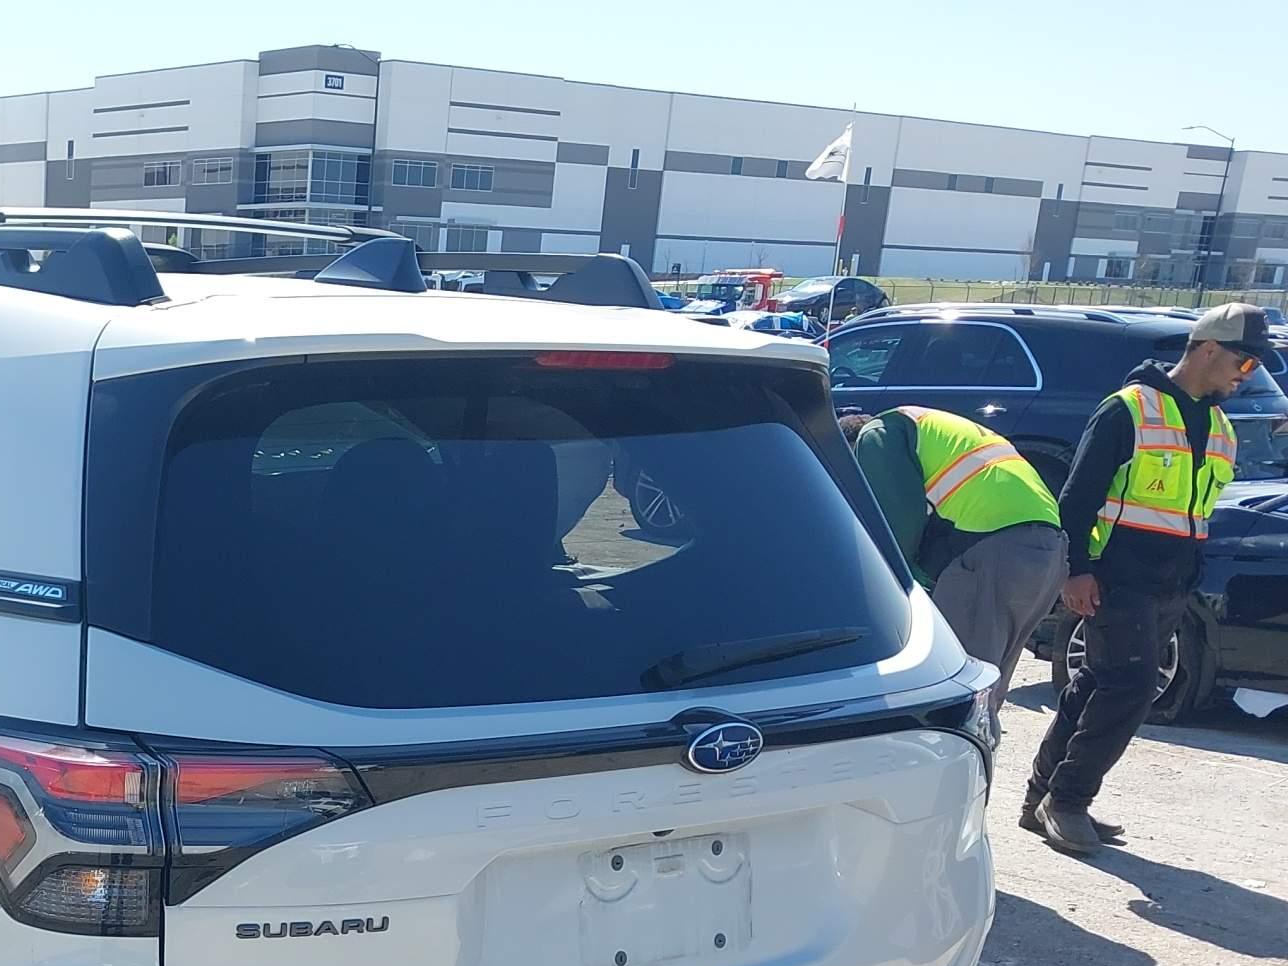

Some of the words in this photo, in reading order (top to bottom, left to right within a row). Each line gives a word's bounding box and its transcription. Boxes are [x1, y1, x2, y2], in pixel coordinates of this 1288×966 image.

[327, 76, 342, 88] 3701
[14, 583, 63, 598] AWD
[476, 753, 900, 829] FORESTER
[236, 916, 390, 939] SUBARU
